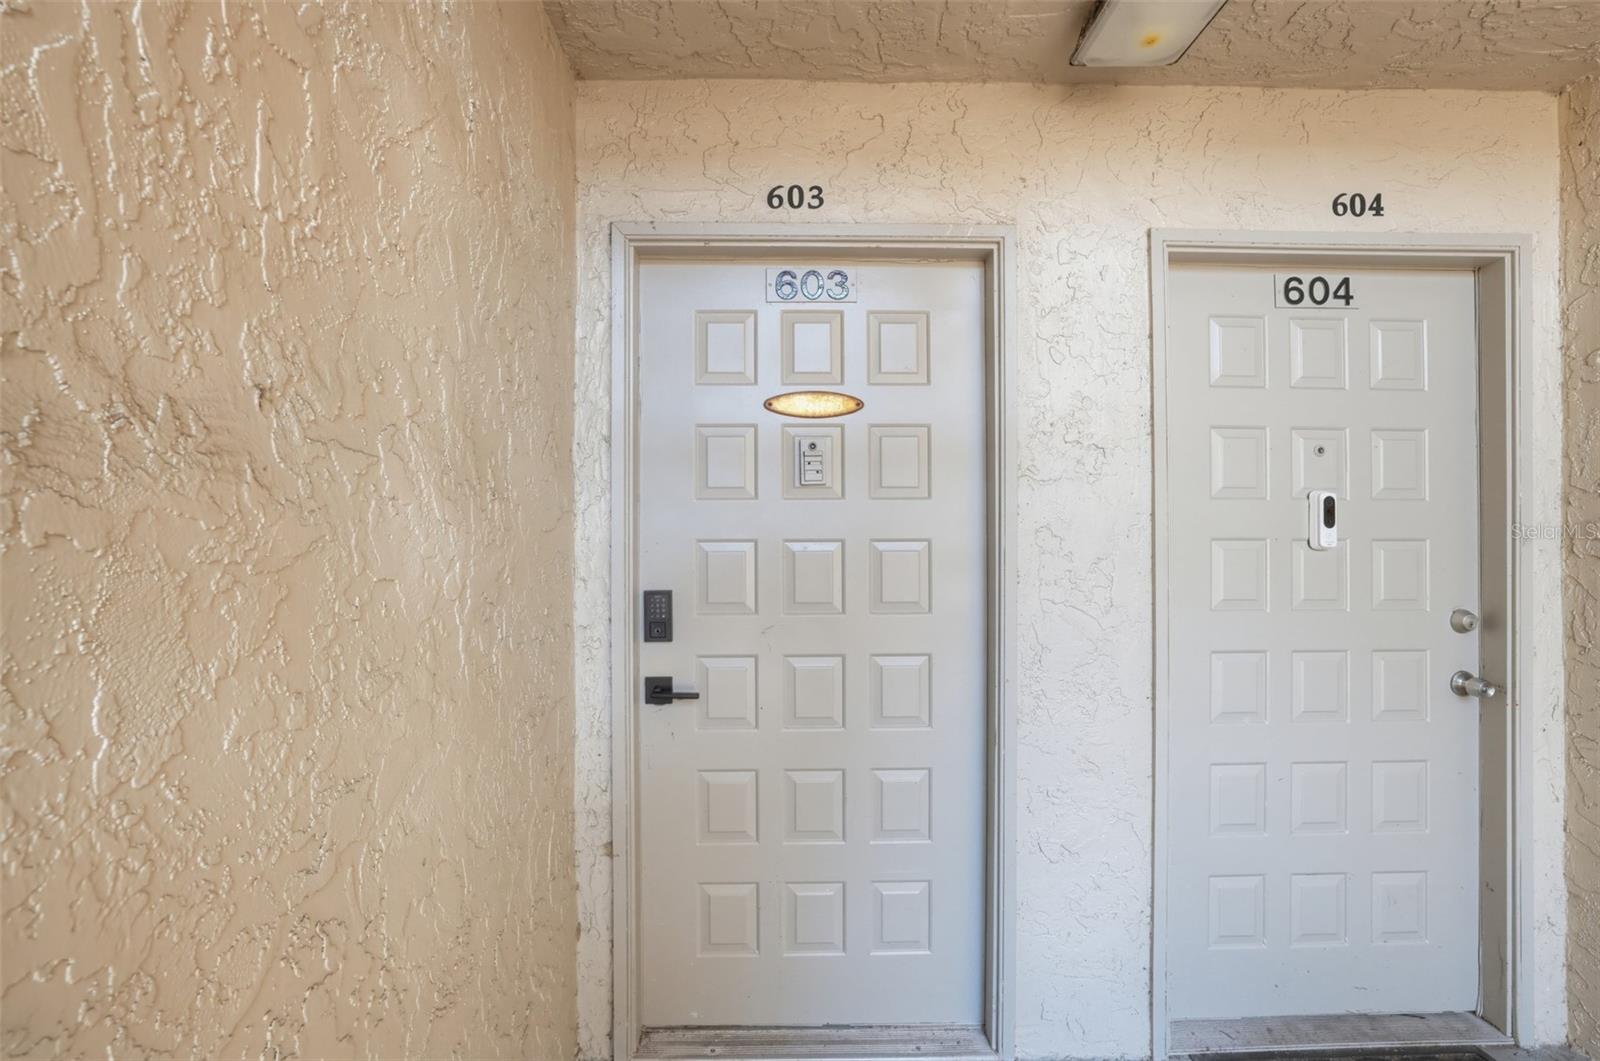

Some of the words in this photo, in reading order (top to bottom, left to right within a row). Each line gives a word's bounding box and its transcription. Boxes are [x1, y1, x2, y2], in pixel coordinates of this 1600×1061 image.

[767, 184, 825, 210] 603
[1332, 193, 1385, 217] 604
[774, 269, 850, 301] 603
[1283, 275, 1355, 307] 604
